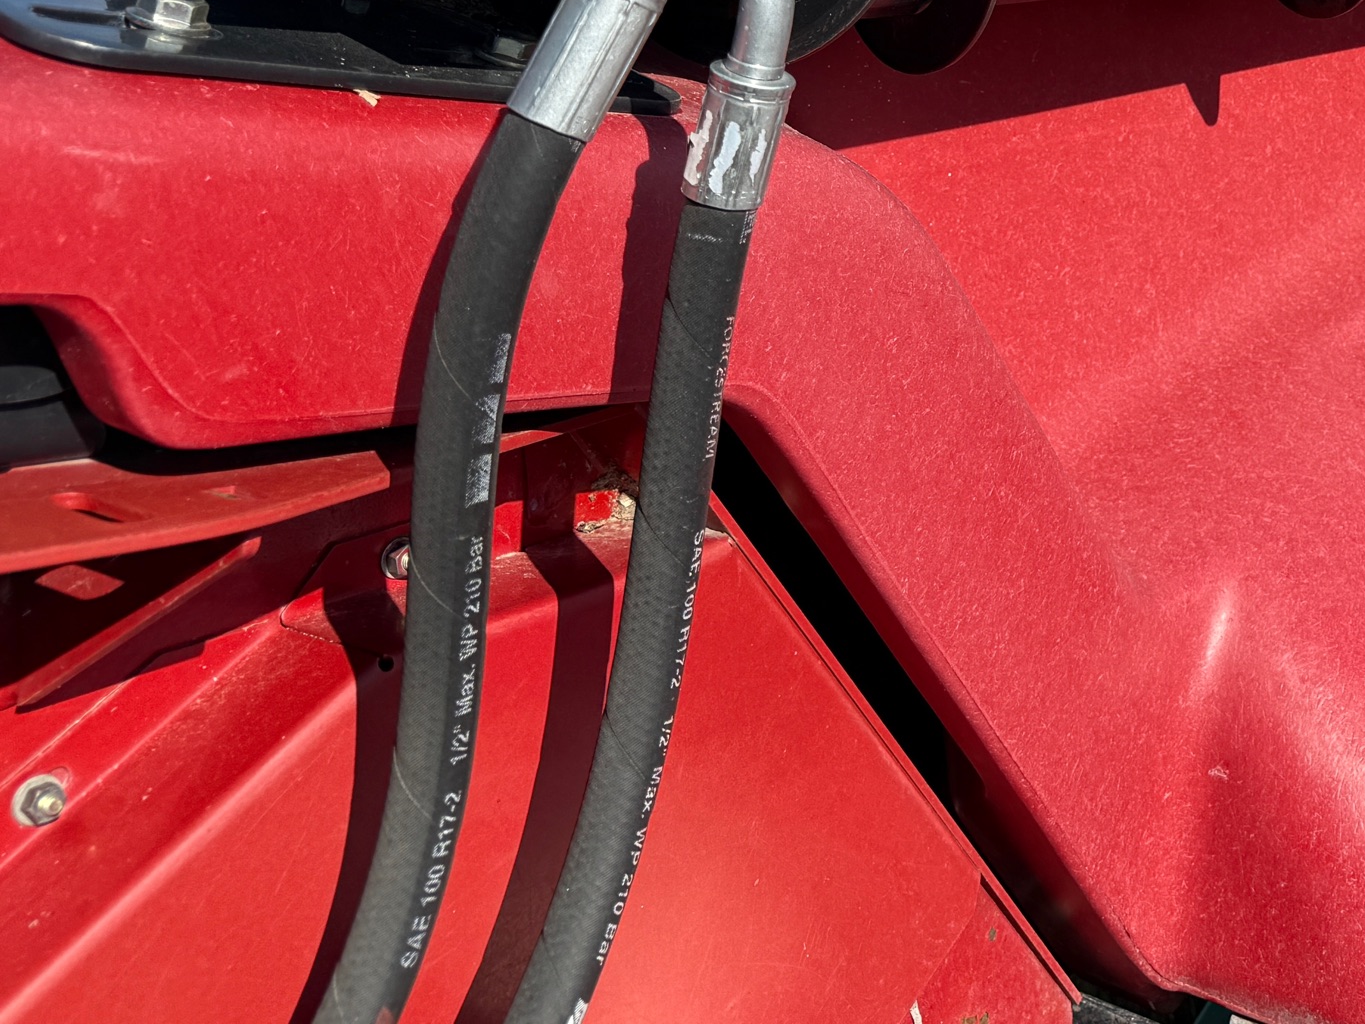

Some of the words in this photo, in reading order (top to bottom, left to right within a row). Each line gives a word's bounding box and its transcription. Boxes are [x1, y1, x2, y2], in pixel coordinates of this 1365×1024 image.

[464, 535, 485, 575] Bar
[463, 577, 483, 619] 210
[682, 581, 697, 621] 100
[458, 623, 479, 662] WP
[670, 624, 692, 690] R17-2
[454, 662, 477, 718] Max.
[450, 724, 471, 766] 1/2"
[658, 714, 675, 757] 1/2"
[641, 765, 664, 819] Max.
[431, 789, 463, 859] R17-2
[630, 826, 648, 866] WP
[420, 863, 446, 907] 100
[612, 872, 634, 917] 210
[400, 913, 433, 969] SAE
[595, 922, 618, 966] Bar
